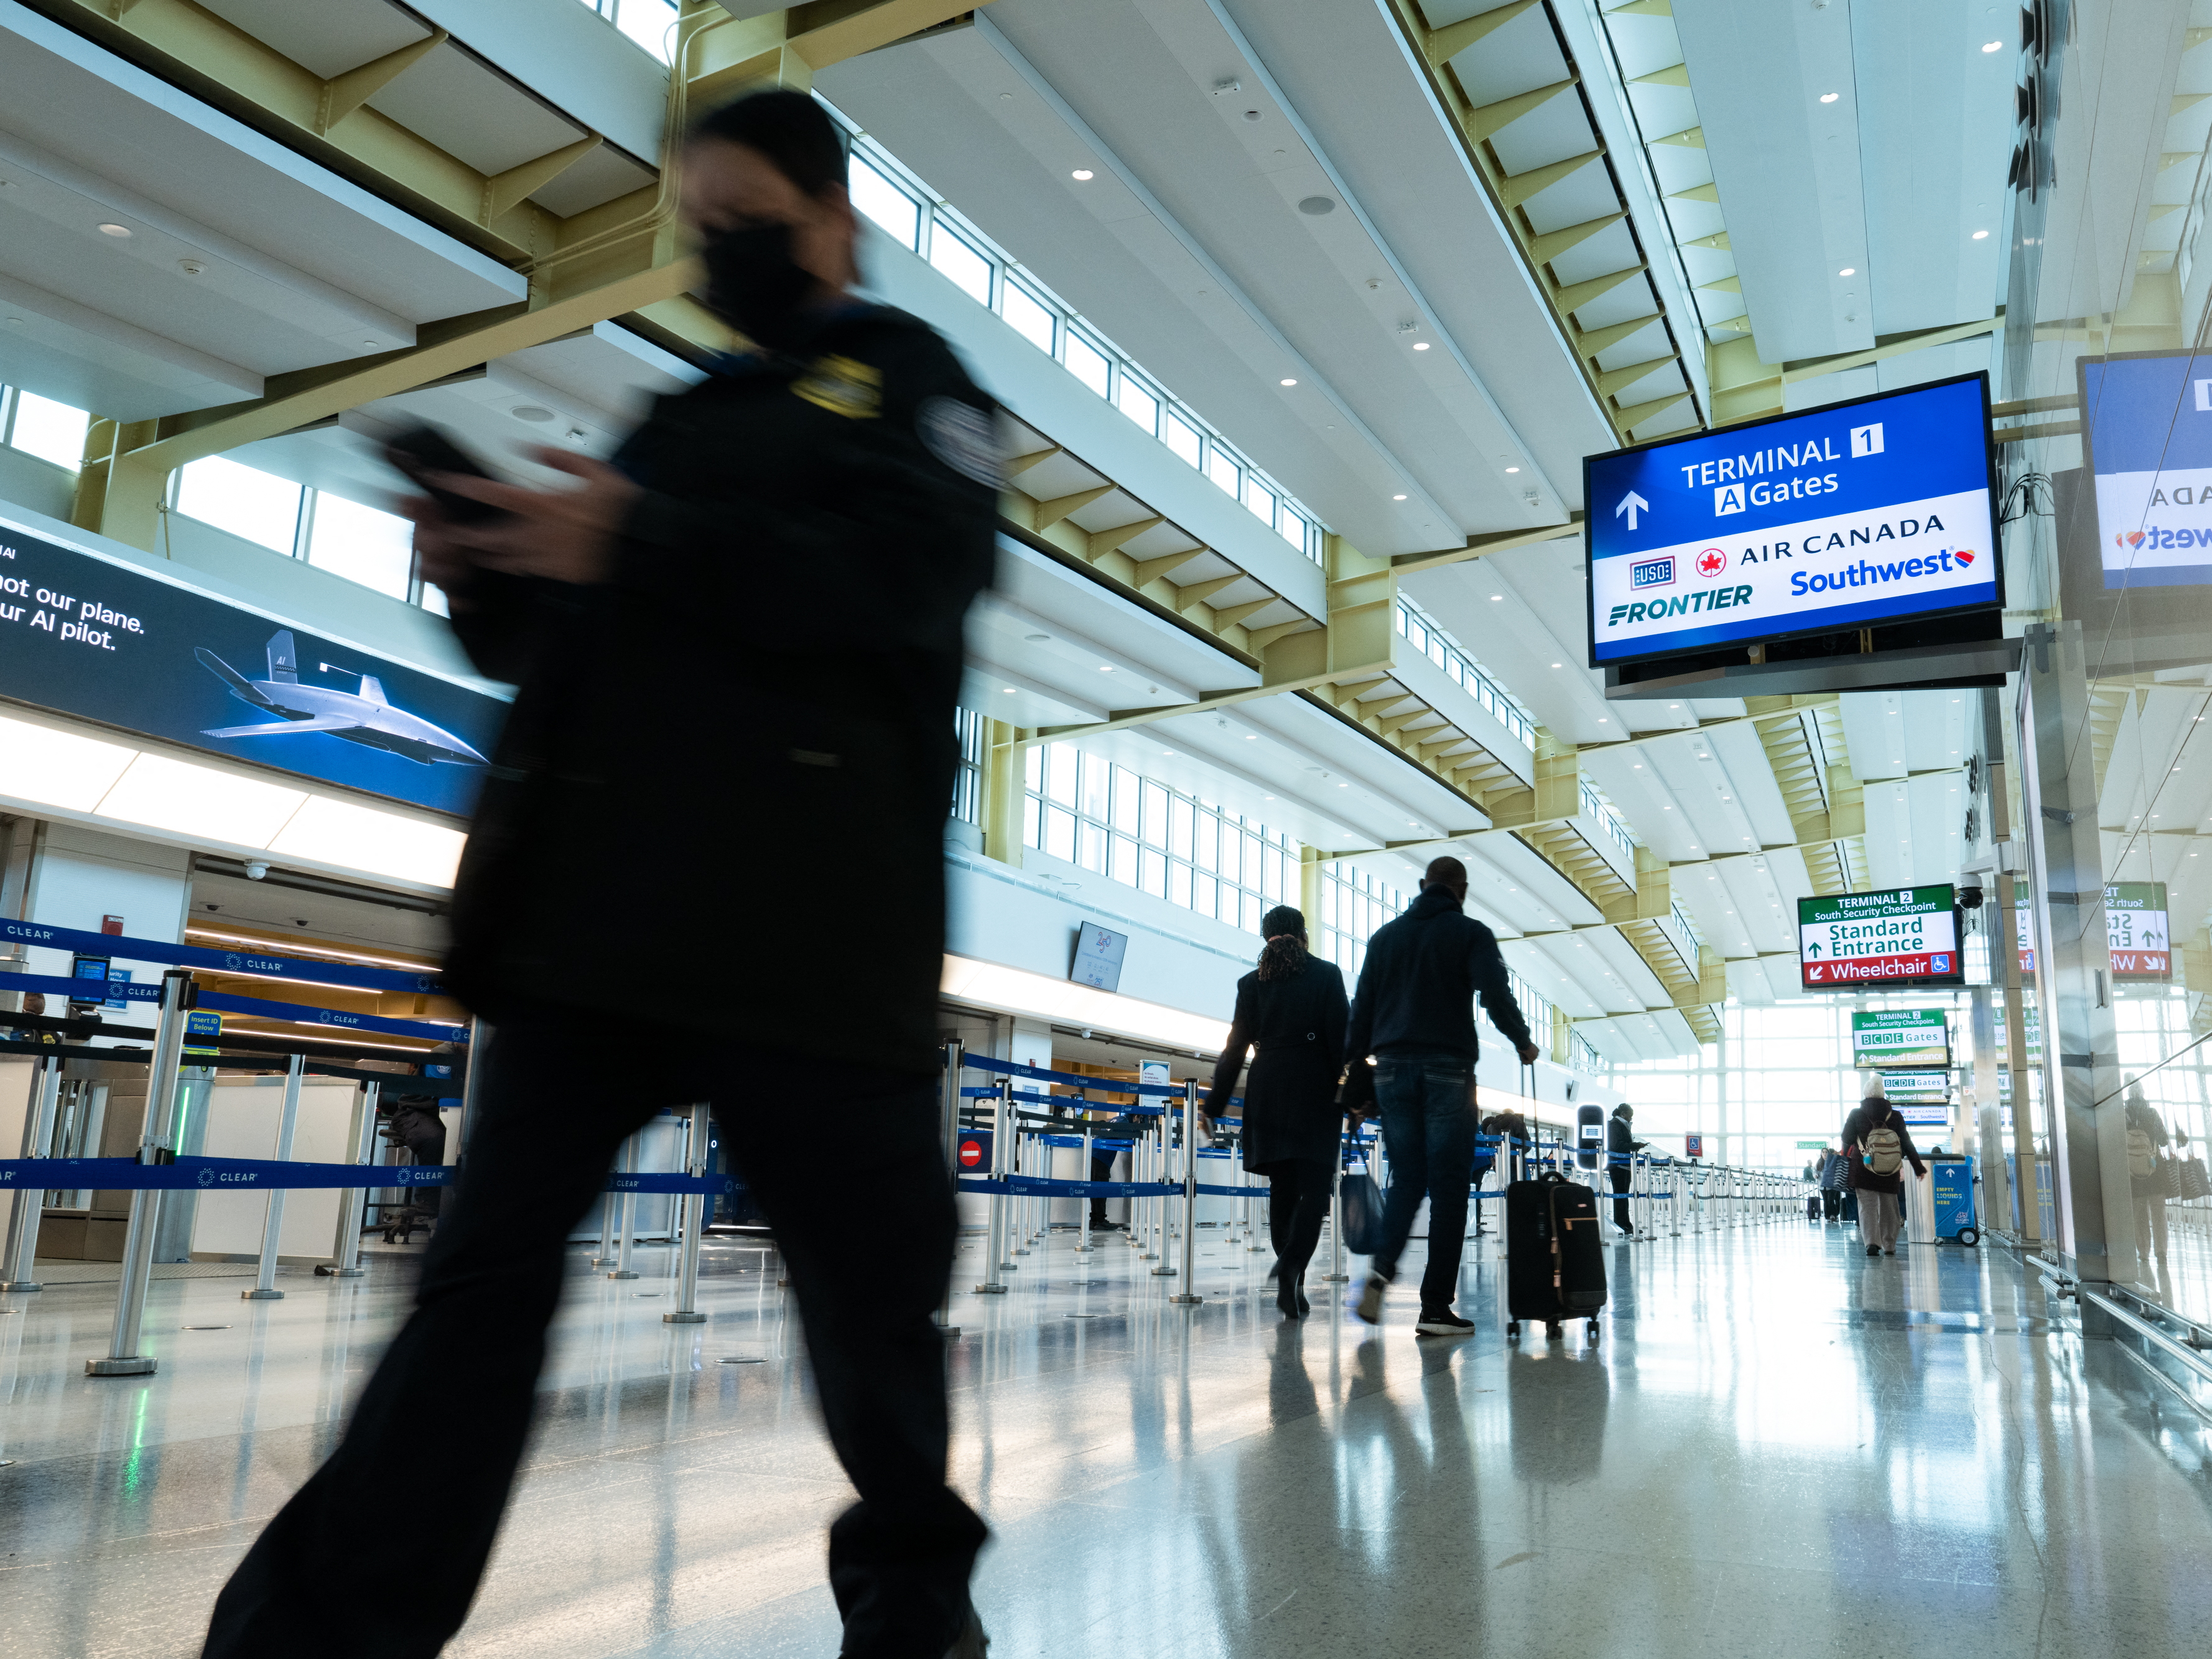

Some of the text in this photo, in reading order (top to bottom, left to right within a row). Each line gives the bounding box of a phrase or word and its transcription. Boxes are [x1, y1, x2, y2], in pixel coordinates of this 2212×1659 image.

[1681, 437, 1841, 488] TERMINAL
[1750, 473, 1838, 506] Gates
[1740, 514, 1945, 565] AIR CANADA
[1640, 564, 1665, 582] USO
[1791, 549, 1953, 596] Southwest
[0, 574, 144, 634] ot our plane.
[1608, 584, 1753, 626] FRONTIER
[0, 602, 116, 651] ur AI pilot.
[277, 656, 286, 665] AI
[1815, 902, 1936, 921] South Security Checkpoint
[1838, 894, 1897, 909] TERMINAL
[1829, 916, 1923, 941] Standard
[1832, 937, 1923, 957] Entrance
[1831, 958, 1927, 979] Wheelchair
[1875, 1013, 1912, 1021] TERMINAL
[1906, 1033, 1938, 1042] Gates
[1869, 1053, 1944, 1063] Standard Entrance
